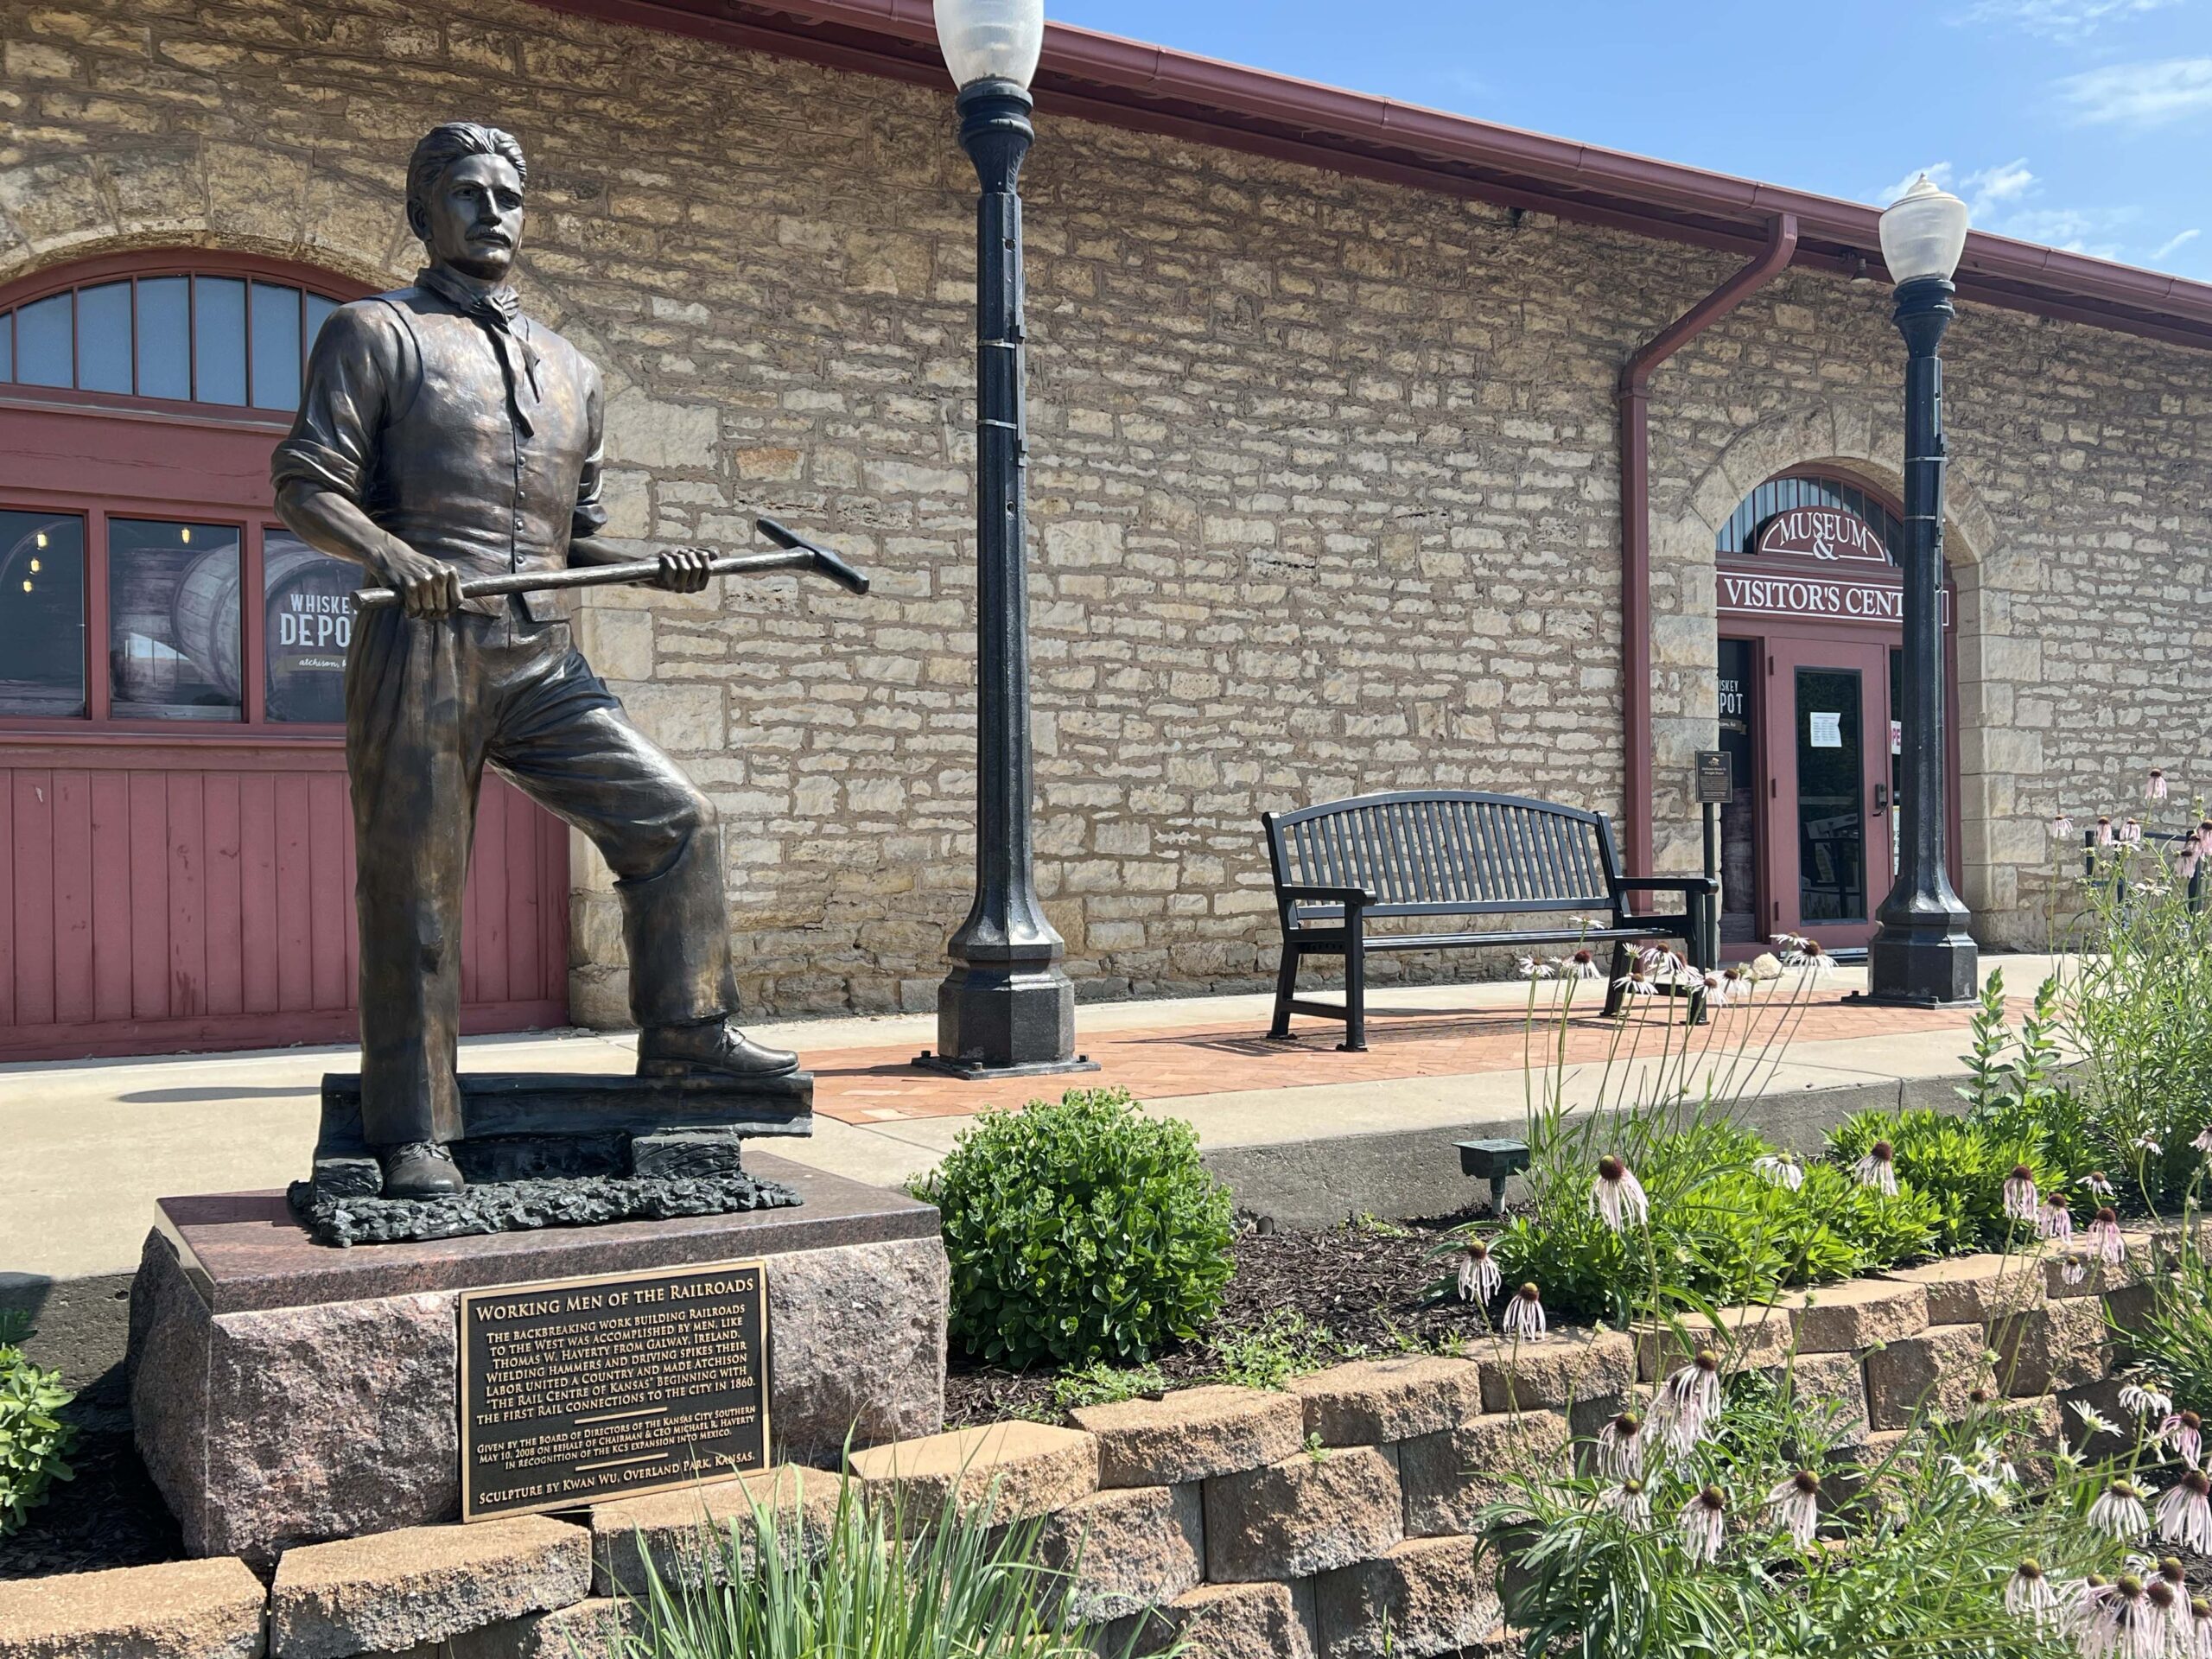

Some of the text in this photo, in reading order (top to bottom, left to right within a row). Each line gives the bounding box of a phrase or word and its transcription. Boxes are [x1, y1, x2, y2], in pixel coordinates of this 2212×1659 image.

[1779, 511, 1869, 555] MUSEUM
[1813, 531, 1840, 560] &
[290, 594, 358, 614] WHISKE
[1724, 578, 1904, 617] VISITOR'S CENT
[279, 613, 352, 648] DEPO
[1719, 679, 1738, 692] ISKEY
[1719, 692, 1744, 715] POT
[476, 1278, 753, 1321] WORKING MEN OF THE RAILROADS
[486, 1304, 745, 1344] THE BACKBREAKING WORK BUILDING RAILROADS
[490, 1345, 505, 1357] TO
[509, 1342, 531, 1354] THE
[534, 1338, 564, 1351] WEST
[568, 1335, 589, 1346] WAS
[593, 1325, 675, 1344] ACCOMPLISHED
[678, 1323, 690, 1333] BY
[721, 1317, 743, 1328] LIKE
[486, 1341, 747, 1383] WIELDING HAMMERS AND DRIVING SPIKES THEIR
[486, 1353, 747, 1396] LABOR UNITED A COUNTRY AND MADE ATCHISON
[493, 1354, 540, 1370] THOMAS
[543, 1351, 557, 1362] W.
[562, 1345, 610, 1361] HAVERTY
[613, 1342, 644, 1354] FROM
[476, 1376, 755, 1425] THE FIRST RAIL CONNECTIONS TO THE CITY IN 1860.
[518, 1394, 543, 1406] RAIL
[546, 1388, 588, 1402] CENTRE
[592, 1385, 606, 1395] OF
[657, 1370, 716, 1387] BEGINNING
[720, 1365, 747, 1377] WITH
[477, 1405, 755, 1453] GIVEN BY THE BOARD OF DIRECTORS OF THE KANSAS CITY SOUTHERN
[480, 1453, 498, 1464] MAY
[515, 1447, 535, 1458] 2008
[537, 1446, 550, 1454] ON
[553, 1440, 582, 1452] BEHALF
[585, 1439, 596, 1447] OF
[599, 1432, 642, 1445] CHAIRMAN
[645, 1430, 652, 1439] &
[653, 1427, 671, 1438] CEO
[673, 1422, 709, 1434] MICHAEL
[721, 1414, 754, 1427] HAVERTY
[505, 1428, 732, 1470] IN RECOGNITION OF THE KCS EXPANSION INTO MEXICO.
[480, 1484, 543, 1504] SCULPTURE
[546, 1481, 560, 1493] BY
[563, 1477, 594, 1491] KWAN
[598, 1473, 620, 1484] WU,
[623, 1463, 680, 1481] OVERLAND
